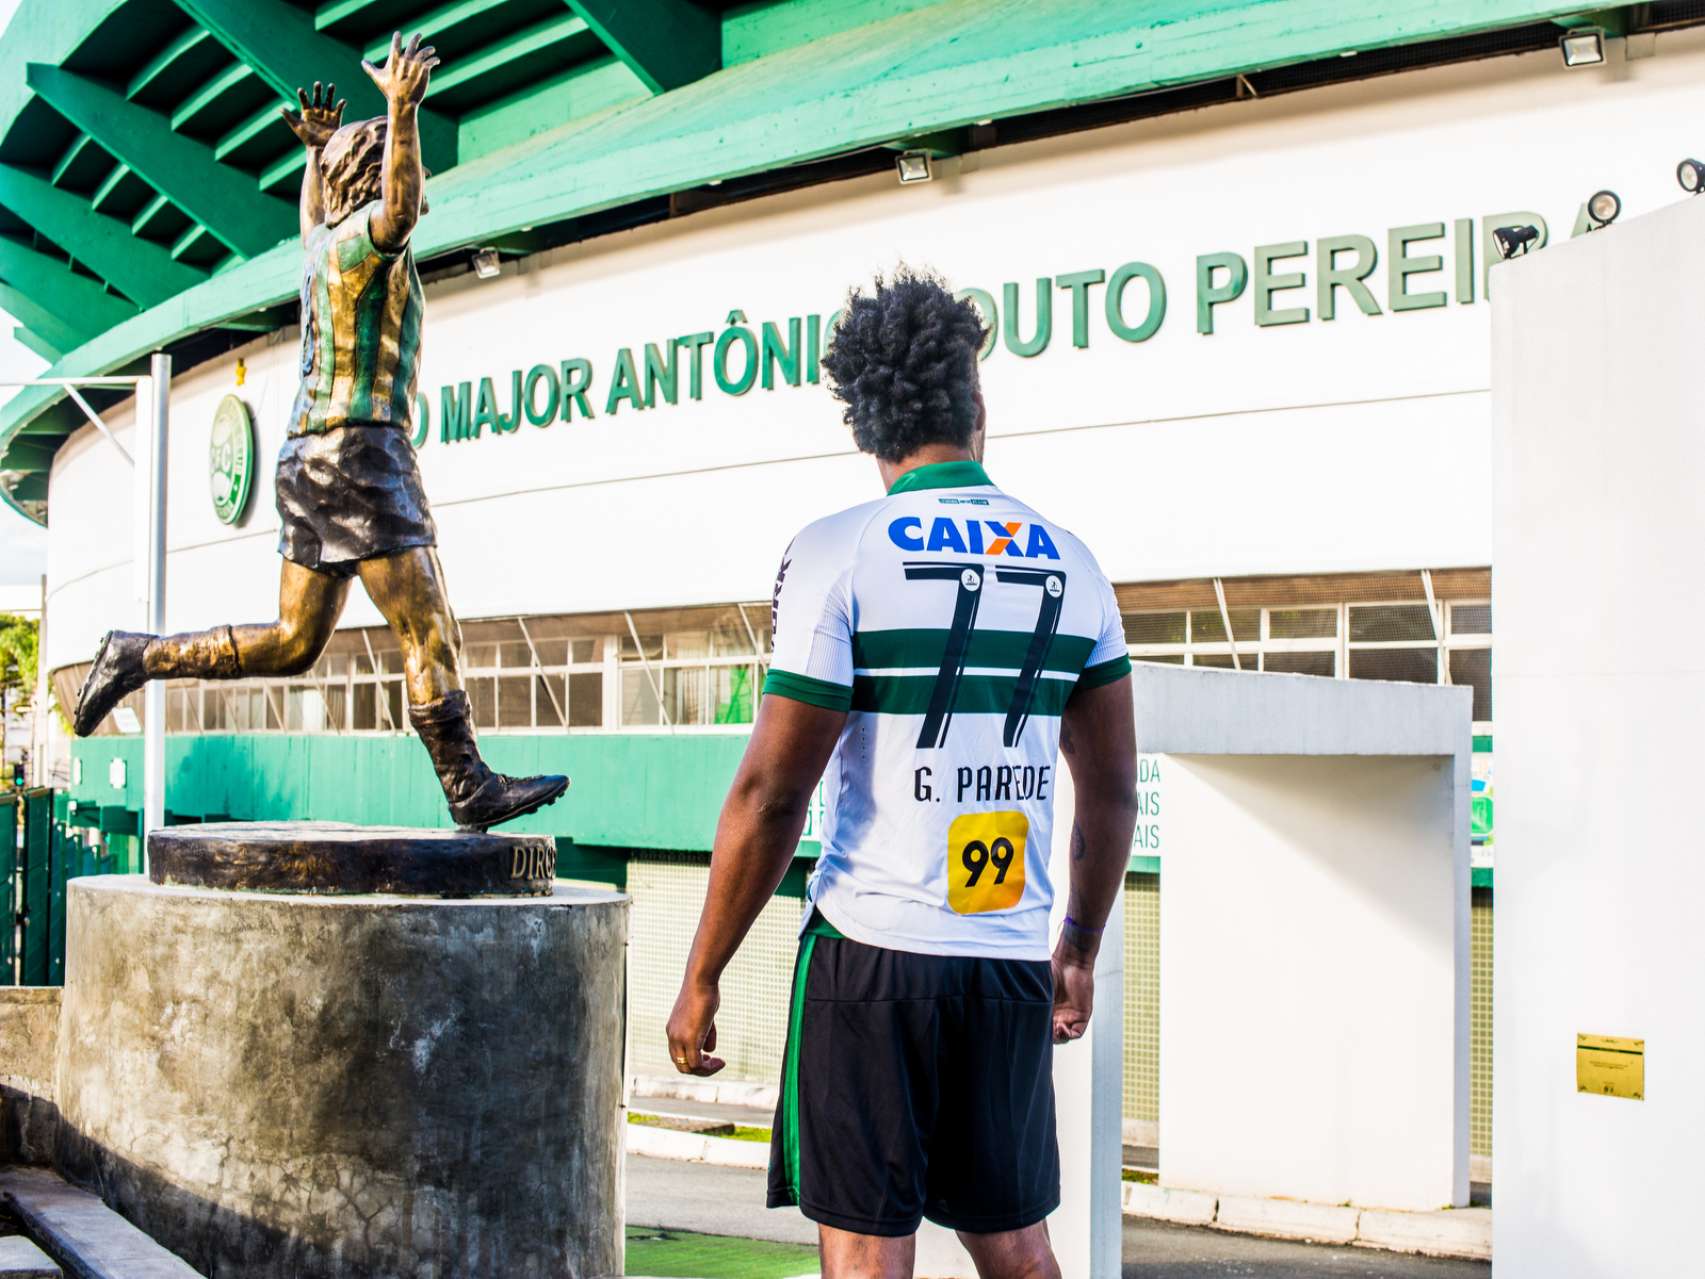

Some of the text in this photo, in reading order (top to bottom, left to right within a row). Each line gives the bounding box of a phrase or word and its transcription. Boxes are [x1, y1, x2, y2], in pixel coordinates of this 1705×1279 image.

[440, 357, 594, 445] MAJOR
[605, 308, 843, 415] ANTÔNI
[957, 261, 1168, 360] OUTO
[888, 515, 1061, 561] CAIXA
[902, 561, 1067, 749] 77
[914, 765, 941, 803] G.
[961, 836, 1015, 889] 99
